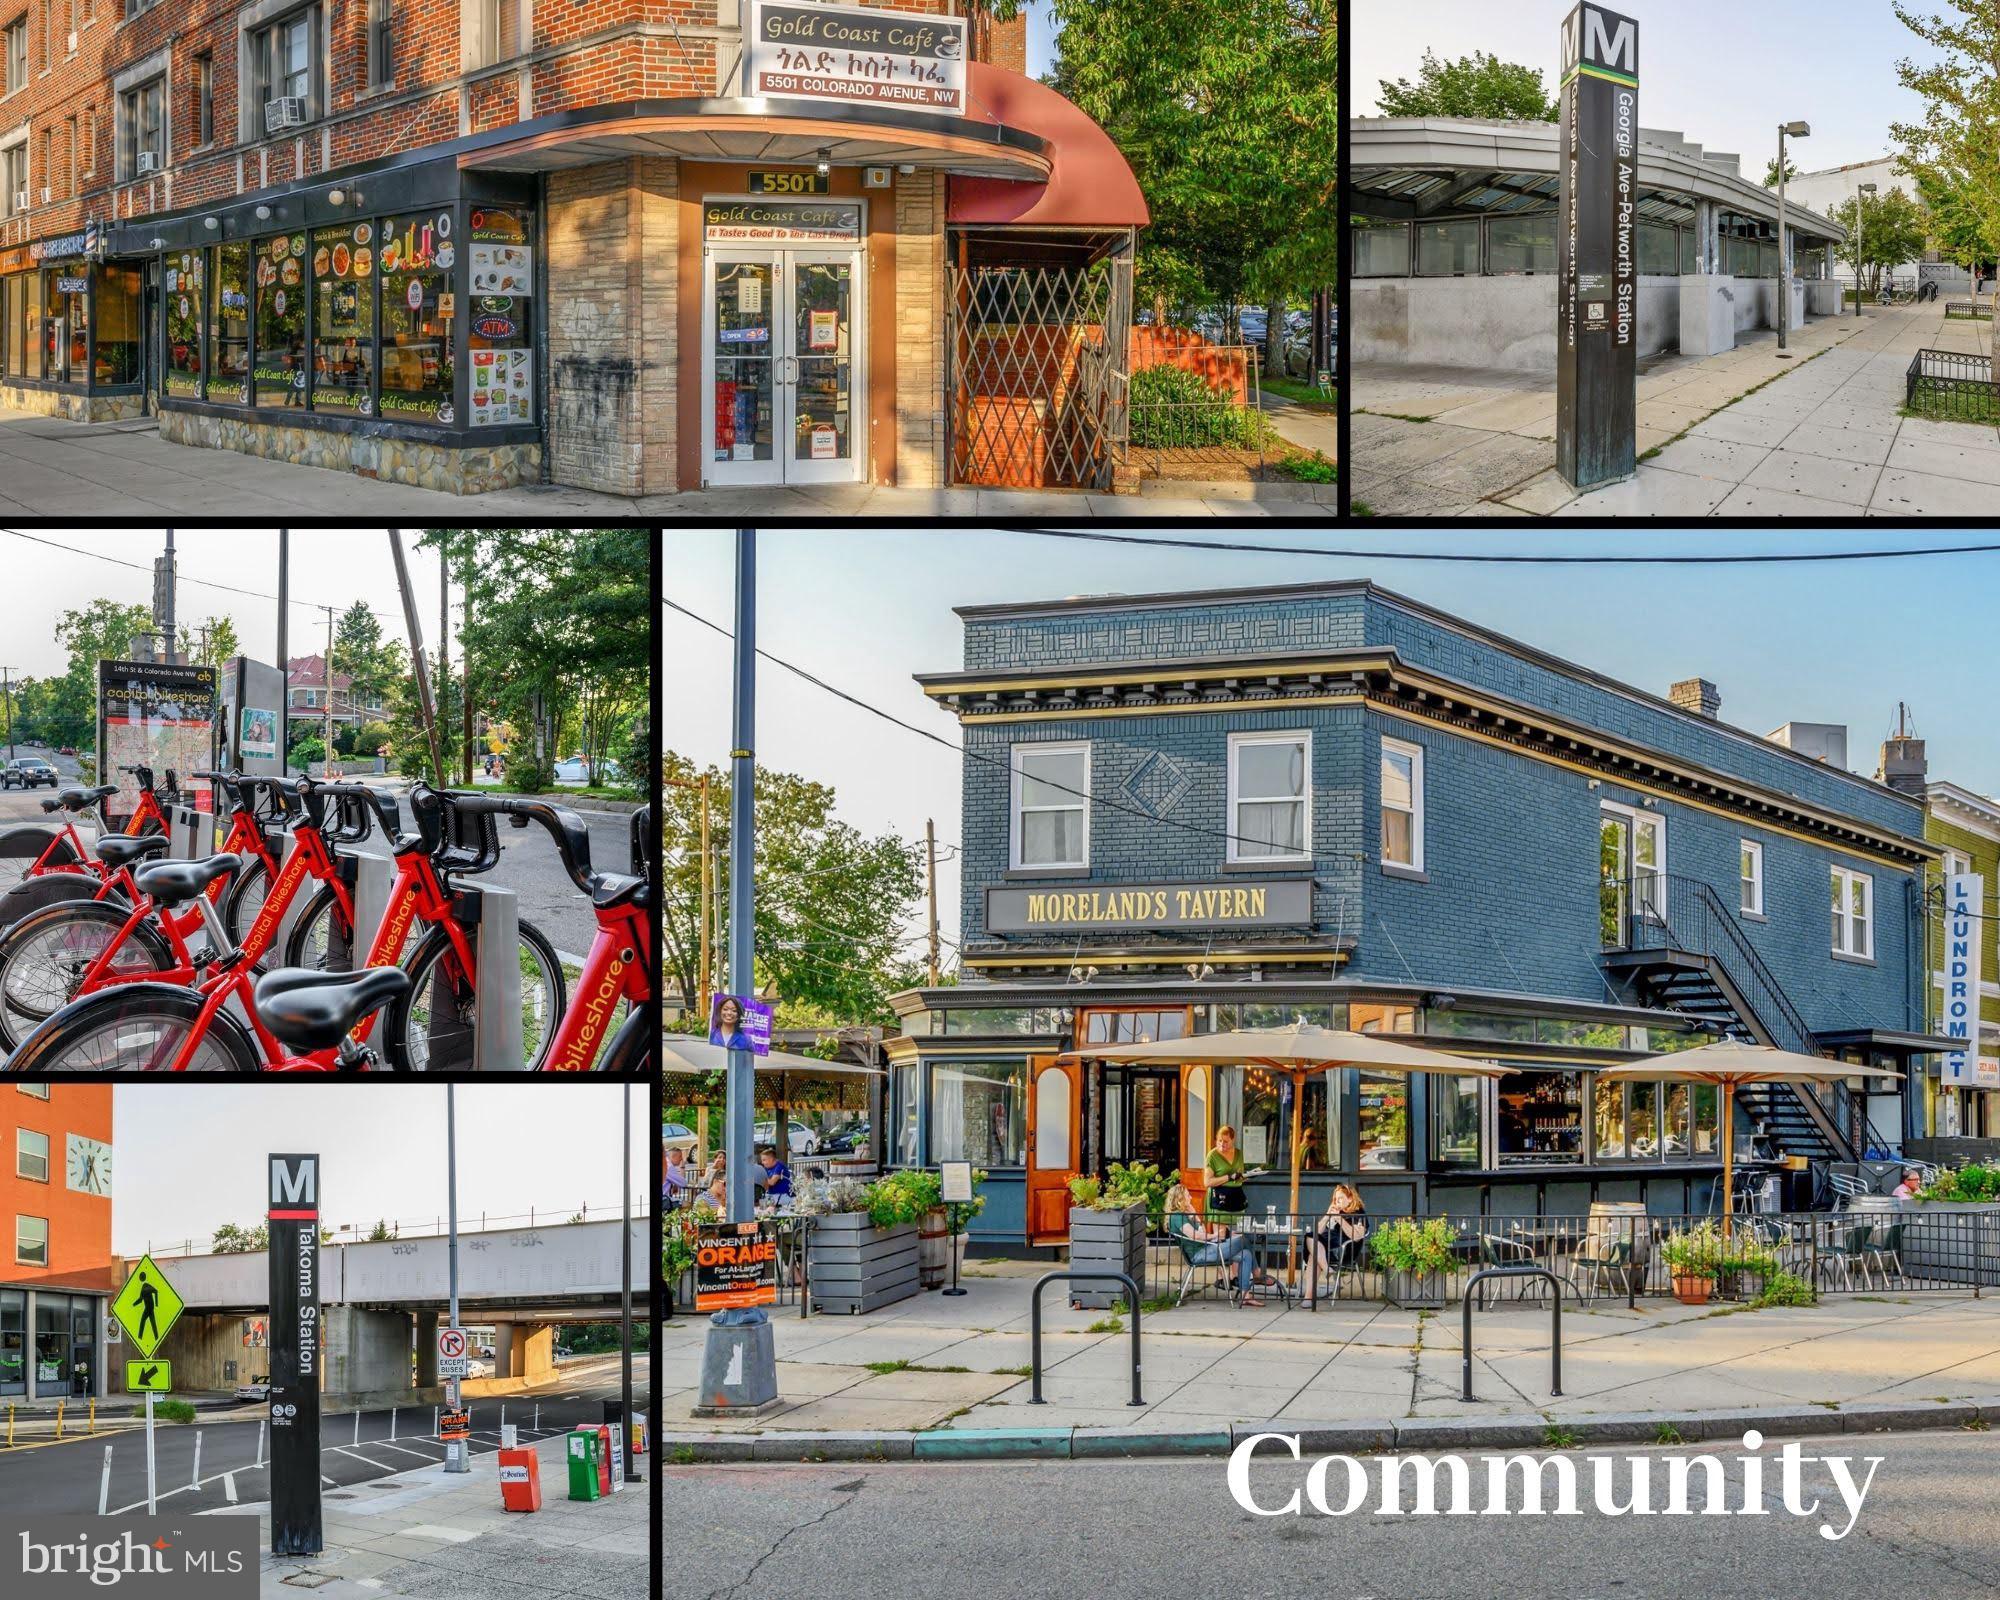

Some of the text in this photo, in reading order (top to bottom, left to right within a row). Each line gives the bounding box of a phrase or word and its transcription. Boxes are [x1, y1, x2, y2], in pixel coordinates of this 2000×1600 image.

[766, 15, 934, 54] Gold Coast Café
[1562, 9, 1580, 73] M
[1584, 8, 1636, 73] M
[766, 76, 955, 103] 5501 COLORADO AVENUE, NW
[1570, 84, 1578, 153] Georgia
[763, 174, 815, 192] 5501
[708, 207, 837, 228] Gold Coast Café
[719, 229, 747, 238] Tastes
[750, 229, 773, 238] Good
[776, 229, 786, 238] To
[1616, 92, 1634, 345] Georgia Ave-Petworth Station
[472, 232, 489, 240] Gold
[481, 322, 509, 334] ATM
[1568, 283, 1576, 346] Station
[254, 368, 267, 381] Gold
[267, 370, 282, 380] Coast
[312, 391, 326, 405] Gold
[326, 393, 343, 404] Coast
[379, 396, 438, 418] Gold Coast Café
[114, 665, 129, 673] 14th
[144, 667, 171, 676] Colorado
[245, 856, 306, 959] capital bikeshare
[1028, 888, 1266, 923] MORELAND'S TAVERN
[368, 889, 416, 968] bikeshare
[555, 959, 623, 1071] bikeshare
[272, 1160, 314, 1203] M
[699, 1237, 750, 1248] VINCENT
[300, 1224, 316, 1374] Takoma Station
